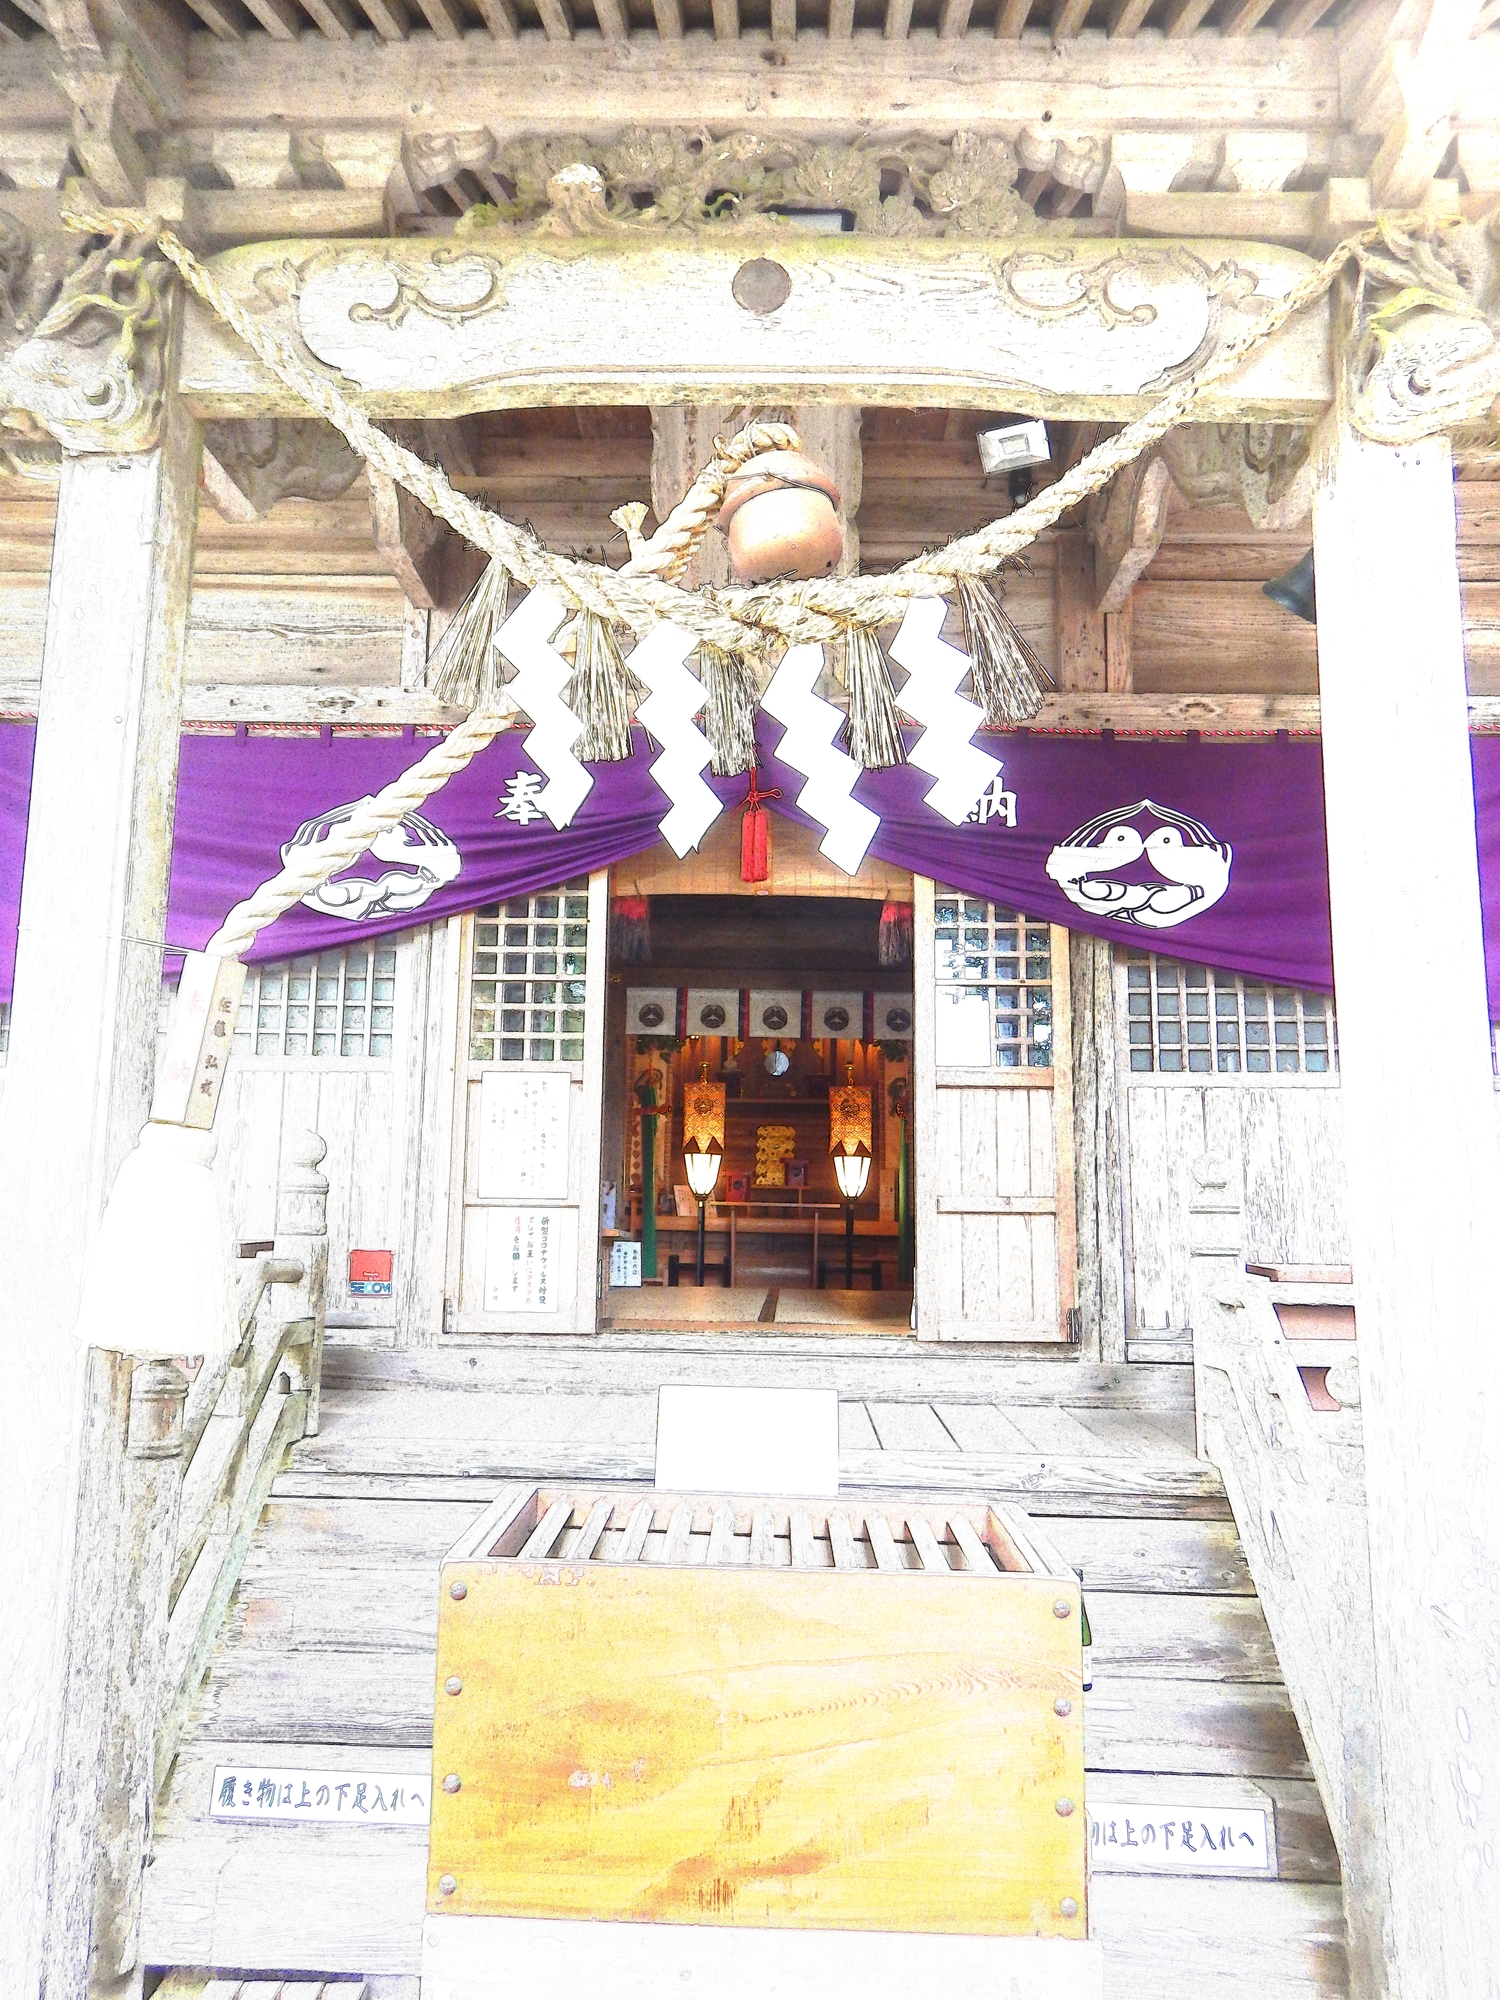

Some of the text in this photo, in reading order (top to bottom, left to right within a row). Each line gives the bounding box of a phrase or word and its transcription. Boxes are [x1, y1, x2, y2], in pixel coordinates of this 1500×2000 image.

[493, 769, 545, 826] 奉
[350, 1281, 391, 1294] SECOM
[217, 1775, 425, 1814] 履き物は上の下足入れへ
